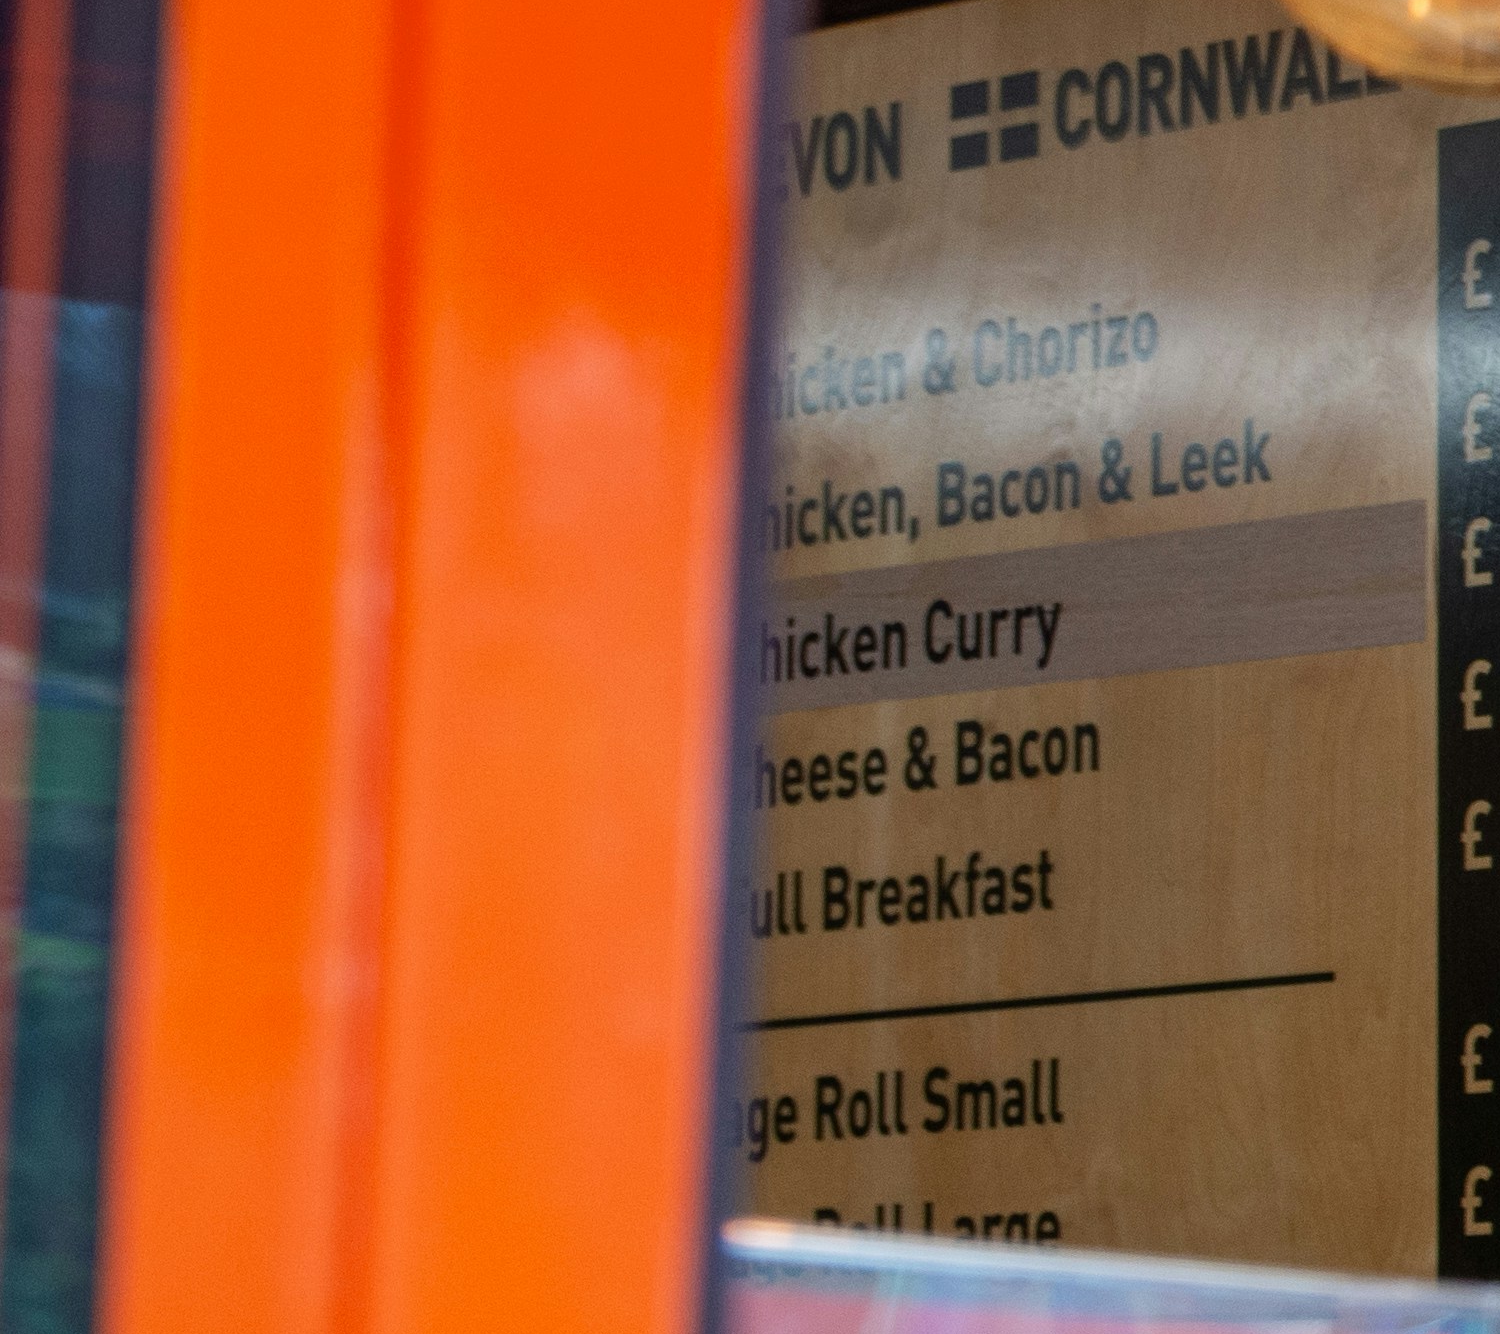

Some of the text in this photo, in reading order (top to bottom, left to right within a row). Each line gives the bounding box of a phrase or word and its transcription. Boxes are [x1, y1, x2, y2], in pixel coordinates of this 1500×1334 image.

[923, 327, 957, 395] &
[973, 301, 1159, 388] Chorizo
[936, 459, 1081, 528] Bacon
[1098, 440, 1133, 504] &
[1149, 419, 1273, 501] Leek
[923, 598, 1063, 669] Curry
[903, 726, 937, 792] &
[955, 719, 1100, 787] Bacon
[822, 850, 1054, 932] Breakfast
[814, 1070, 909, 1141] Roll
[922, 1058, 1064, 1134] Small
